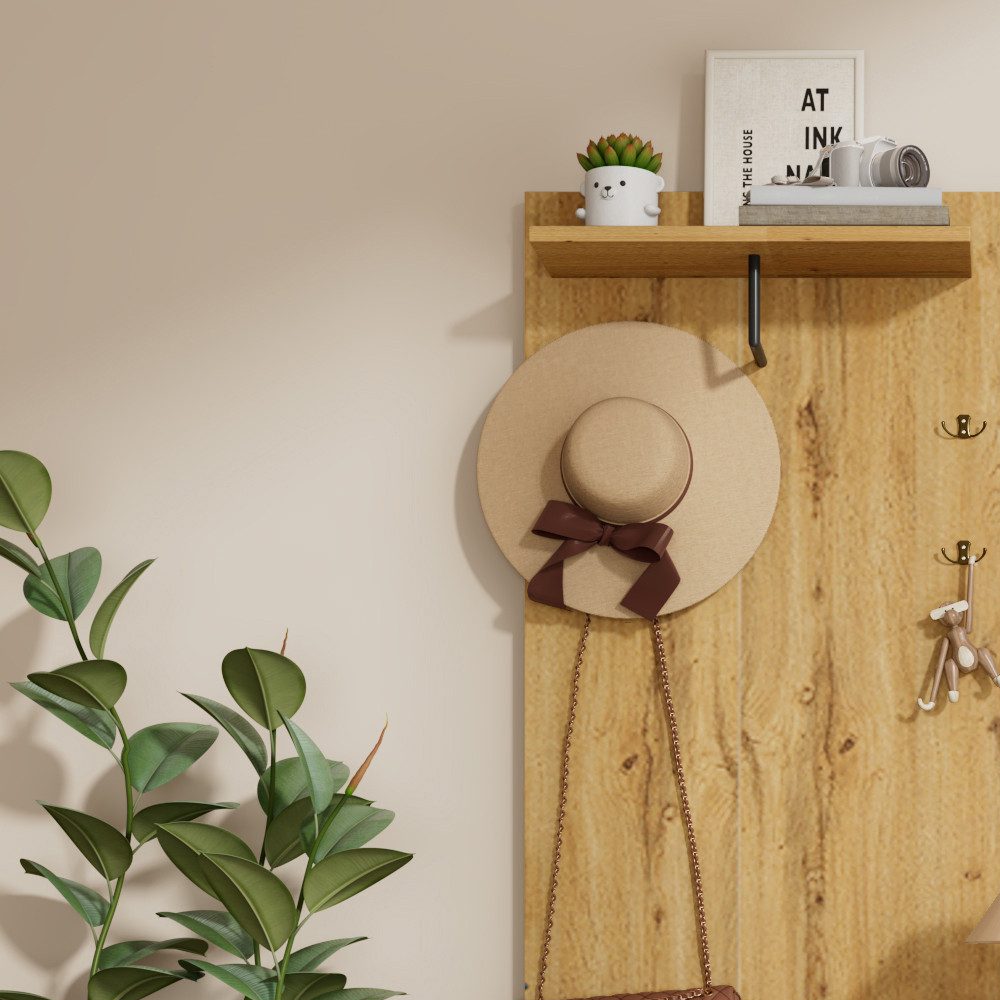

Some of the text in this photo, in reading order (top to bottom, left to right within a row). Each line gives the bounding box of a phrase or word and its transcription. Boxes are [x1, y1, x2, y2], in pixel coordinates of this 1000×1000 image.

[801, 88, 829, 111] AT
[743, 129, 753, 164] HOUSE
[805, 126, 843, 149] INK
[743, 167, 753, 188] THE
